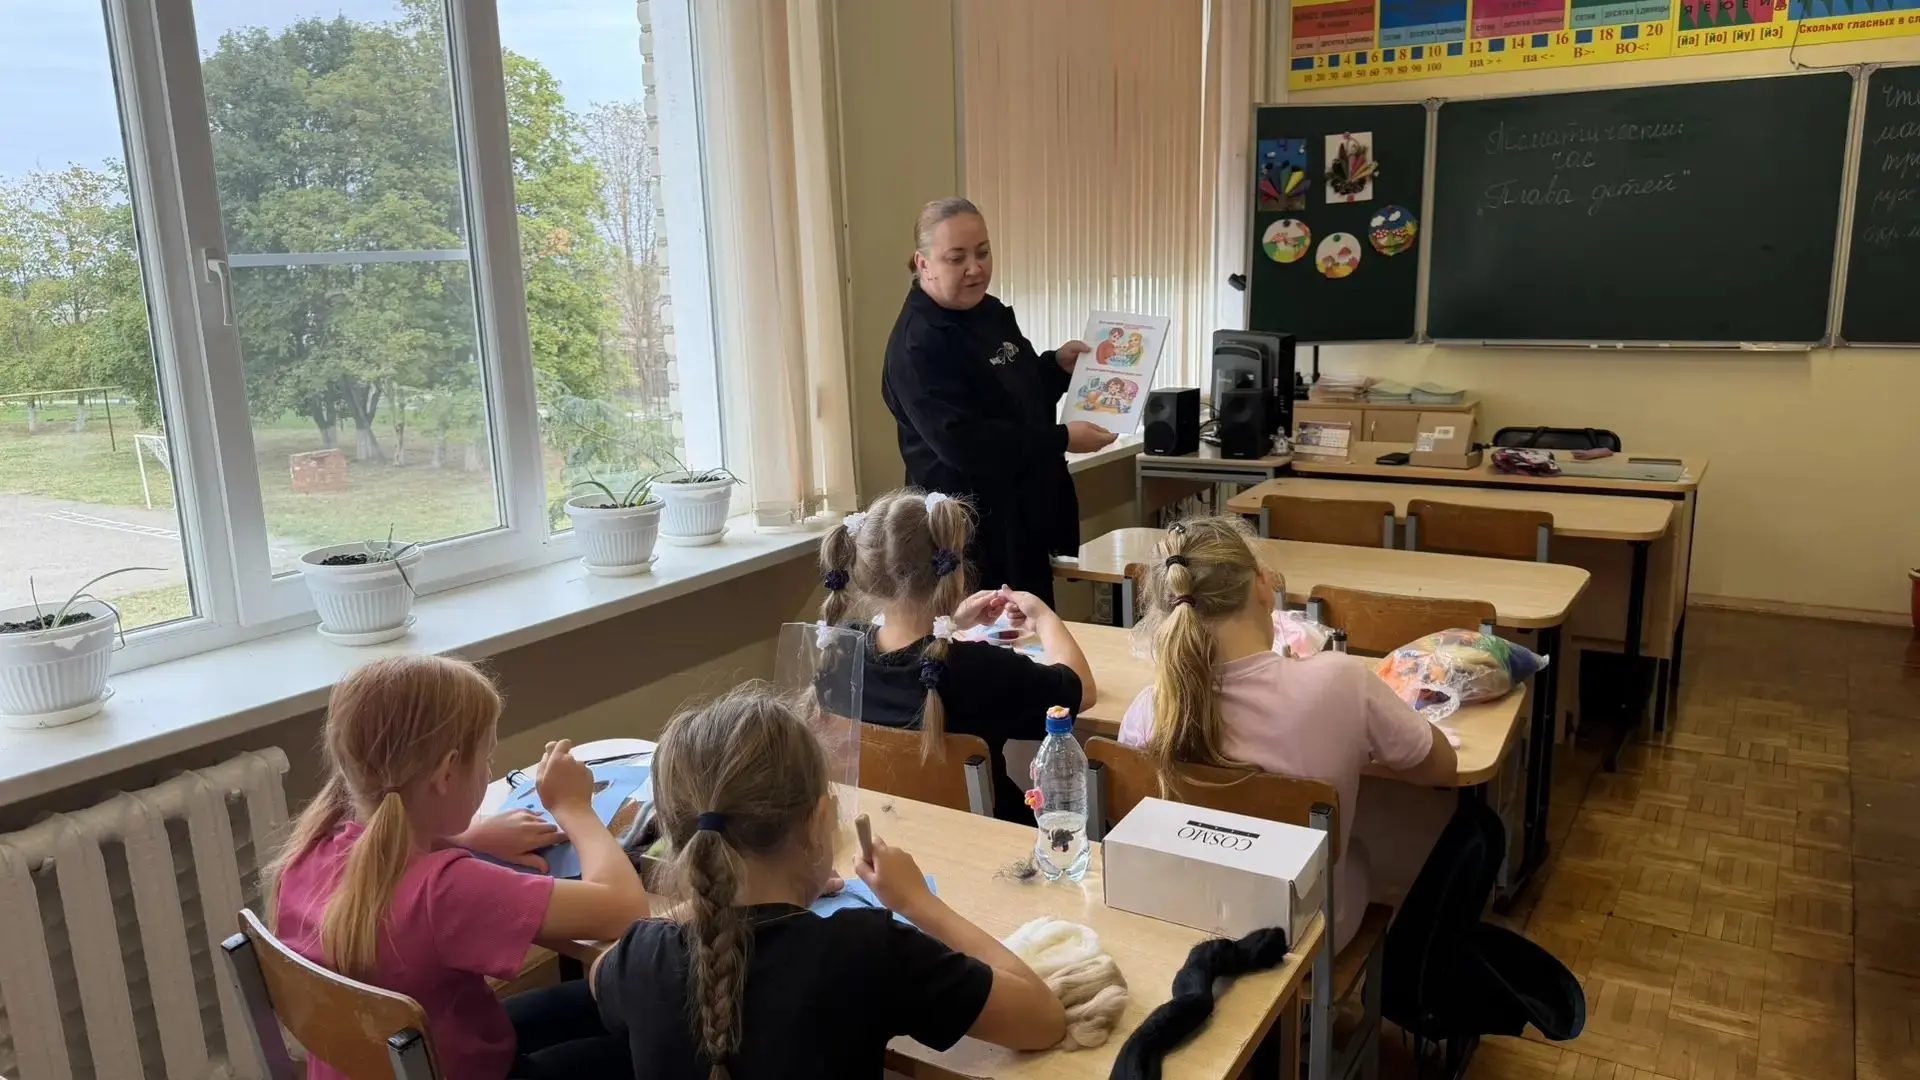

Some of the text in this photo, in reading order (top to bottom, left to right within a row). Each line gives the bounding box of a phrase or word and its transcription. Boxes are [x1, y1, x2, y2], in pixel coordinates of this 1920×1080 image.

[1800, 22, 1844, 33] Сколько
[1847, 17, 1895, 29] гласных
[1898, 16, 1905, 24] в
[1317, 23, 1664, 68] 2 4 6 8 10 12 14 16 18 20
[1315, 73, 1326, 82] 20
[1328, 71, 1339, 81] 30
[1355, 69, 1367, 79] 50
[1369, 68, 1380, 77] 60
[1383, 67, 1394, 76] 70
[1397, 65, 1409, 75] 80
[1411, 64, 1422, 73] 90
[1427, 62, 1442, 72] 100
[1551, 150, 1597, 169] час
[1177, 826, 1253, 852] COSMO
